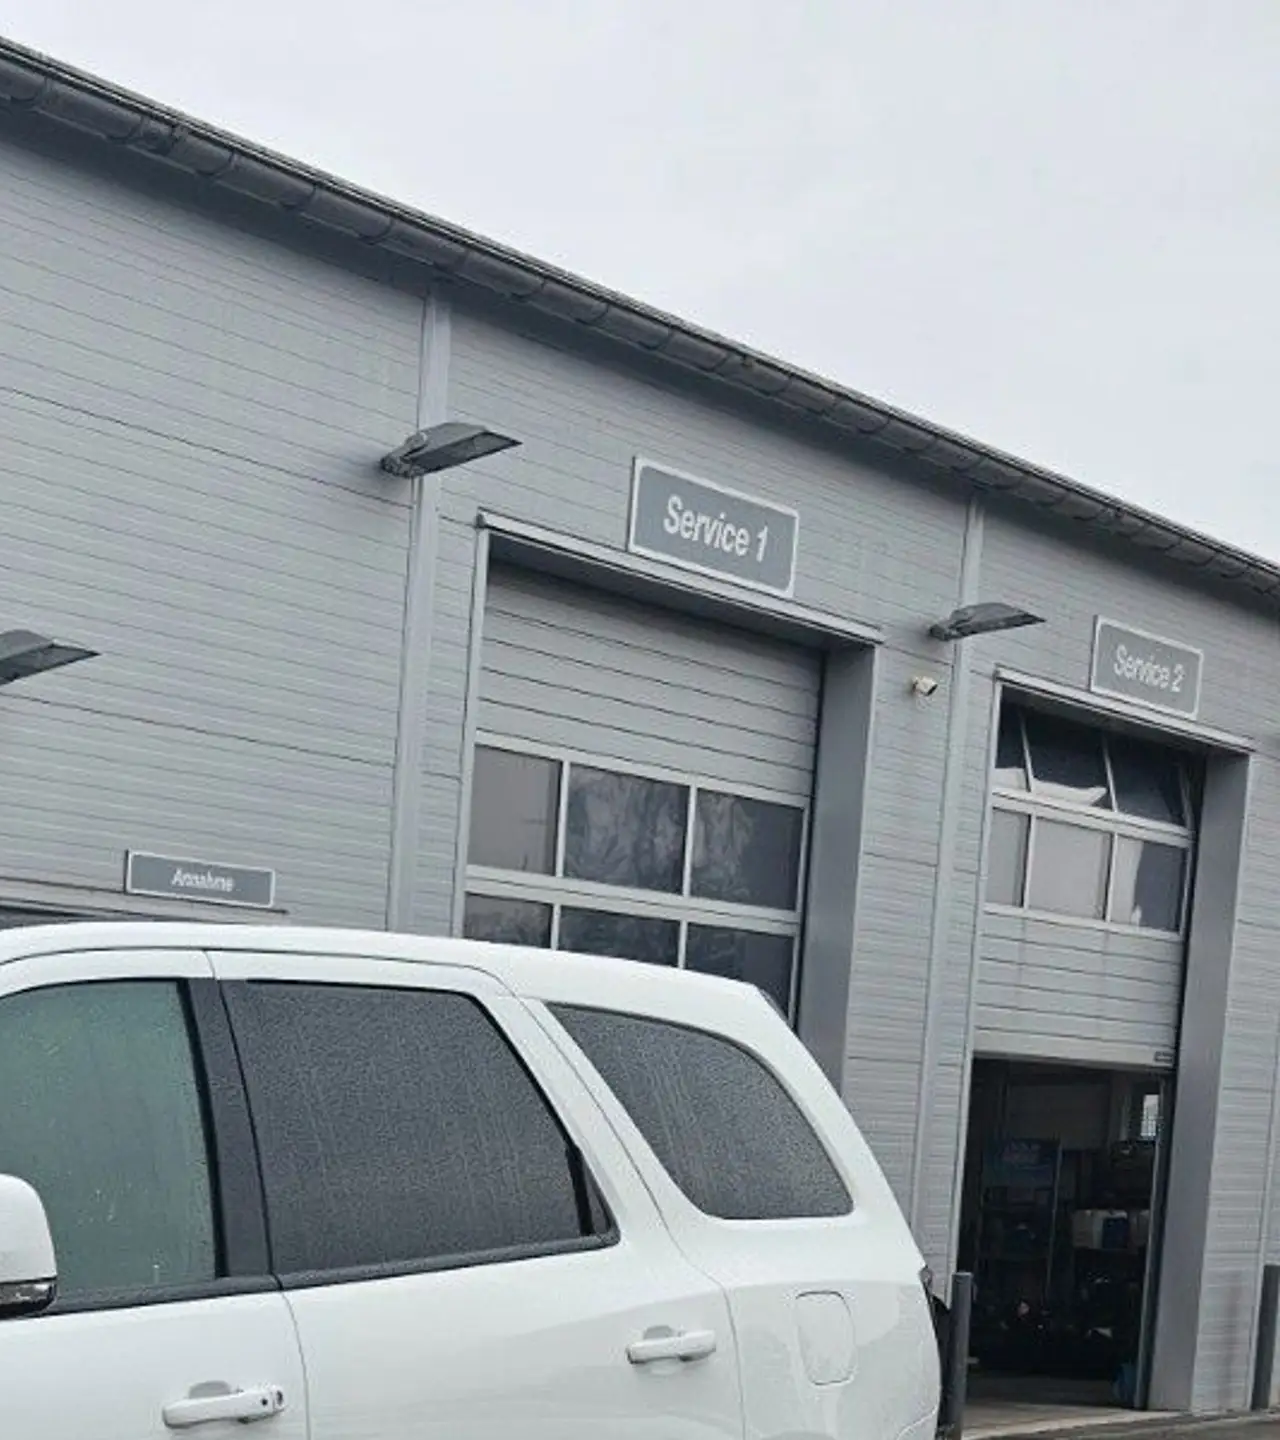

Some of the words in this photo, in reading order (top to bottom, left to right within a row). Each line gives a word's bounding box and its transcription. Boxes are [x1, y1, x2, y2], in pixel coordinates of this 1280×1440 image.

[663, 494, 750, 557] Service
[756, 525, 769, 563] 1
[1113, 644, 1169, 689] Service
[1171, 663, 1185, 692] 2
